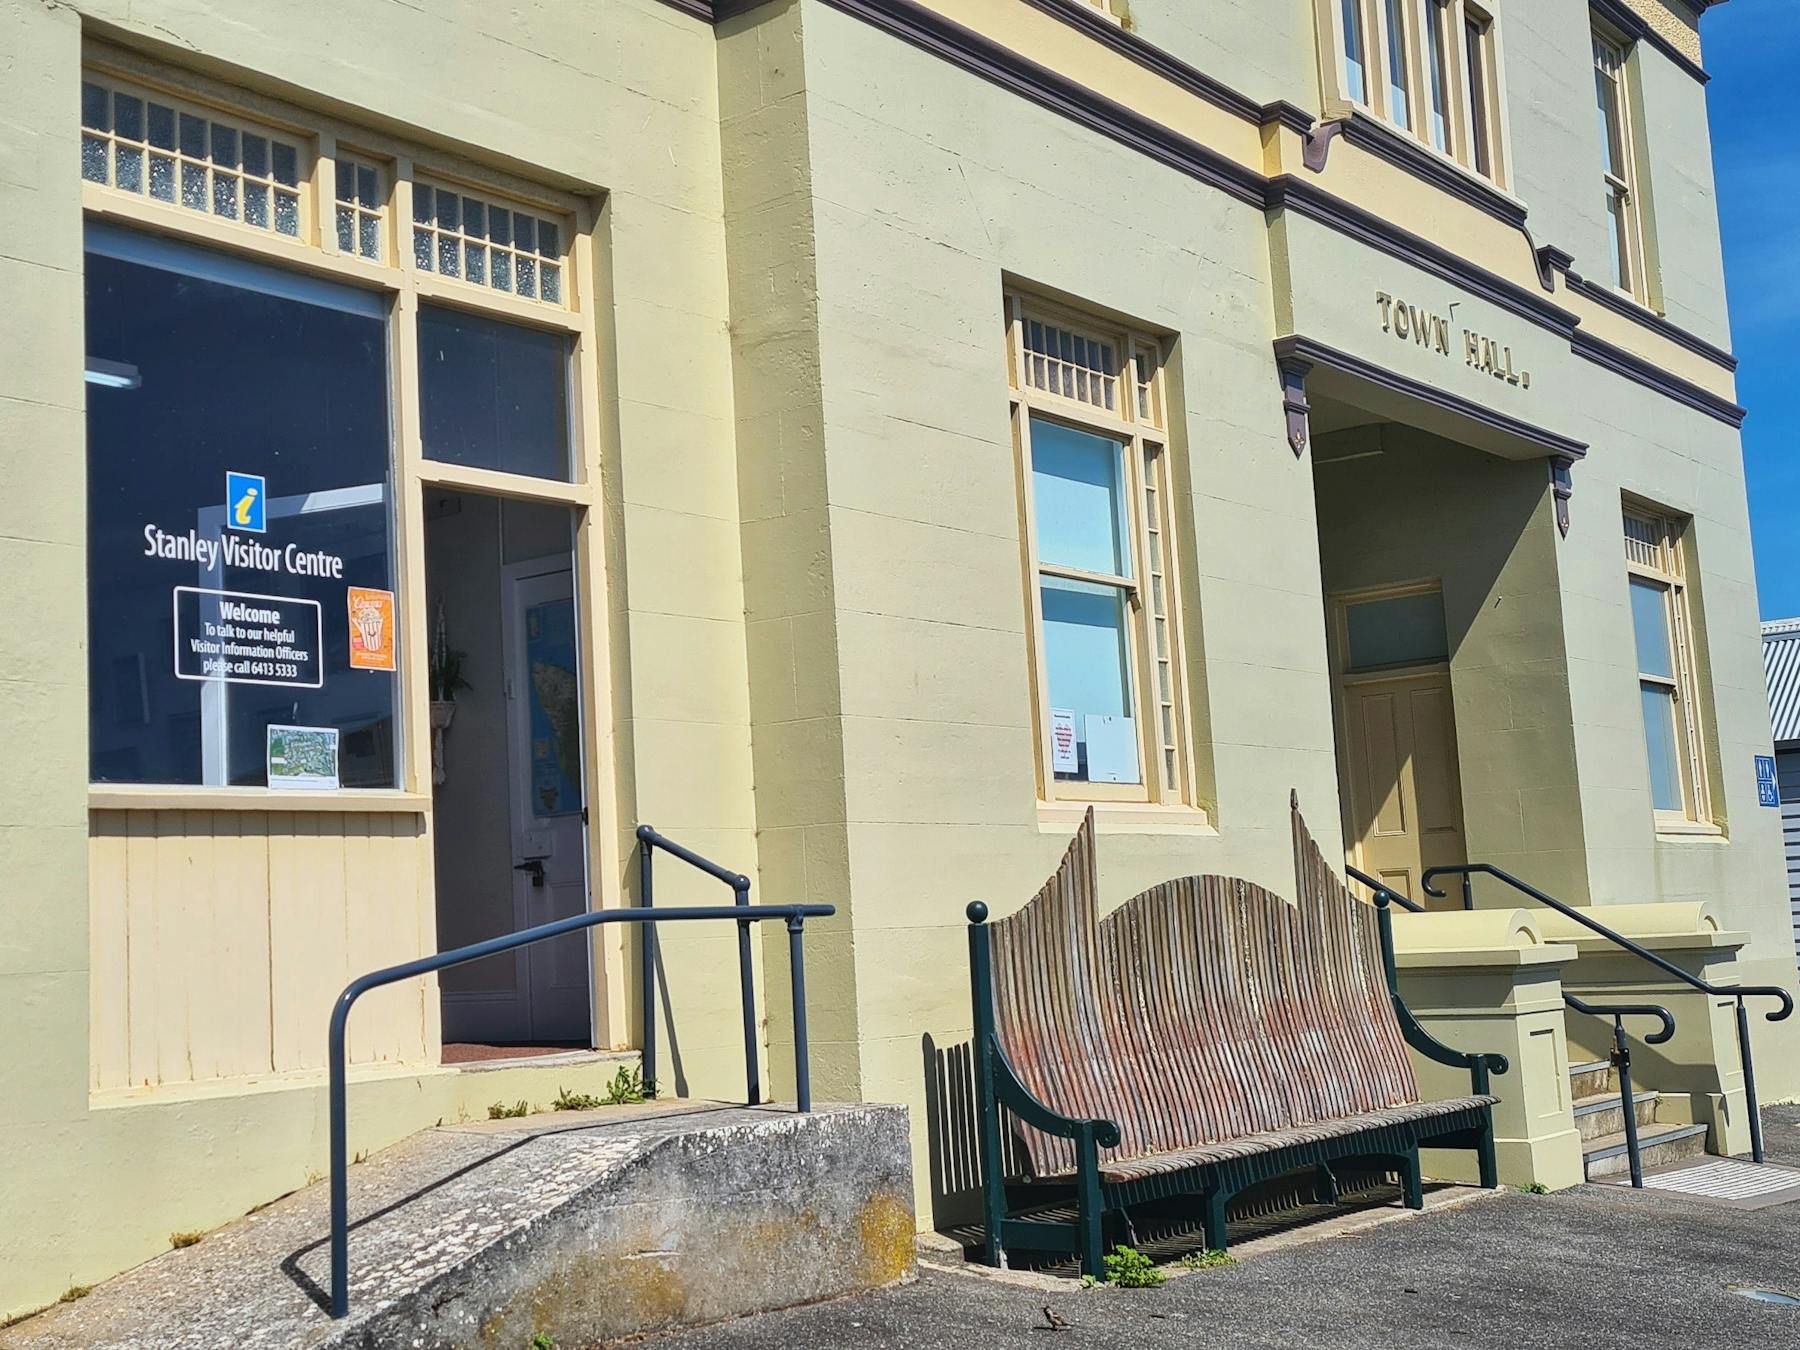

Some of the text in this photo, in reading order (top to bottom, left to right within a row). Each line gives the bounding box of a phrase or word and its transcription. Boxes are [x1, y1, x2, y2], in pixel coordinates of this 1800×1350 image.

[1376, 291, 1450, 357] TOWN
[144, 524, 342, 578] Stanley Visitor Centre
[220, 601, 280, 624] Welcome
[204, 622, 295, 644] To talk to our helpful
[190, 638, 308, 661] Visitor Information Officers
[203, 658, 297, 677] please call 6413 5333
